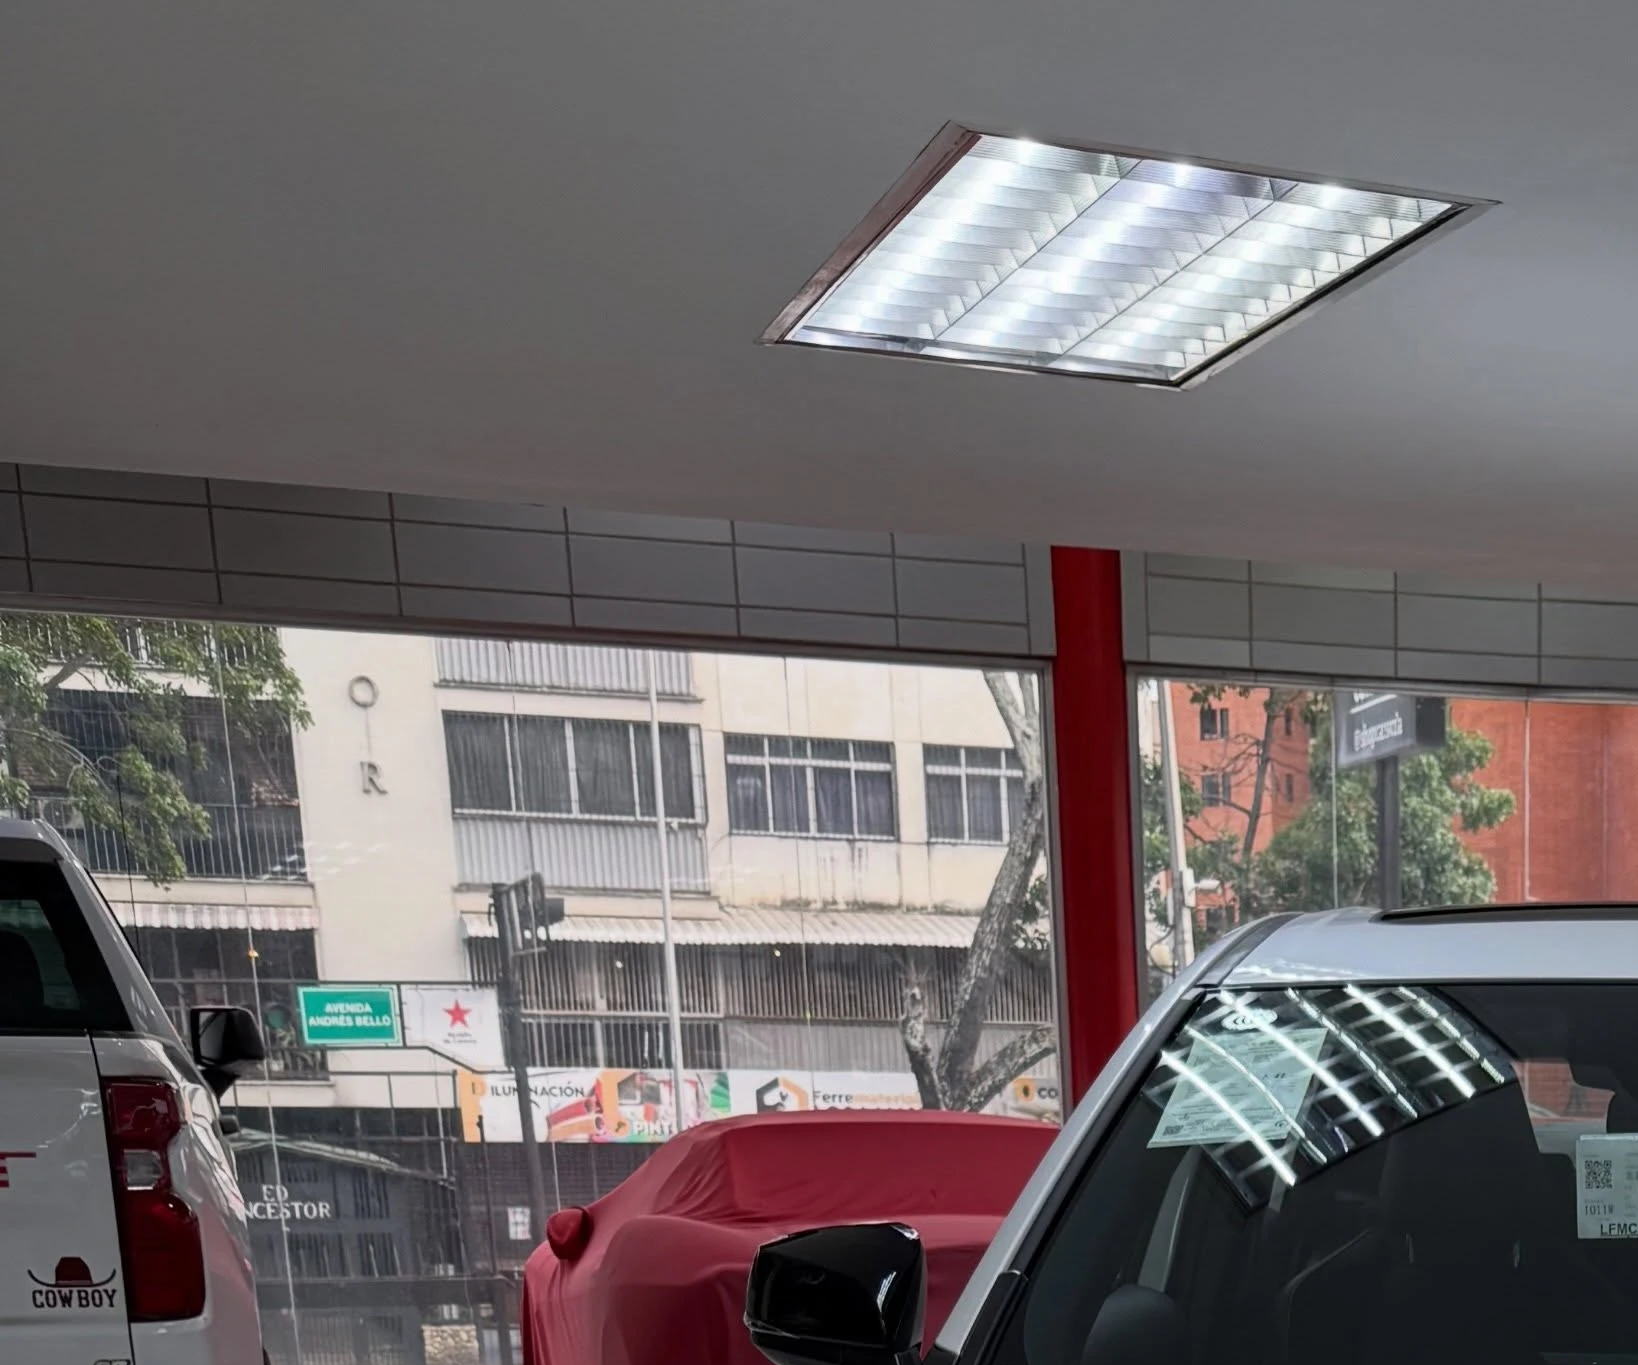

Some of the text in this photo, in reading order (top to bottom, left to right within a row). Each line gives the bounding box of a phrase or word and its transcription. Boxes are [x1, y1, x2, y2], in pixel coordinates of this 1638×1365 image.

[325, 1002, 373, 1014] AVENIDA
[308, 1015, 392, 1027] ANDRÉS BELLO
[490, 1081, 585, 1098] ILUNACIÓN
[262, 1184, 289, 1201] ED
[244, 1201, 332, 1220] NCESTOR
